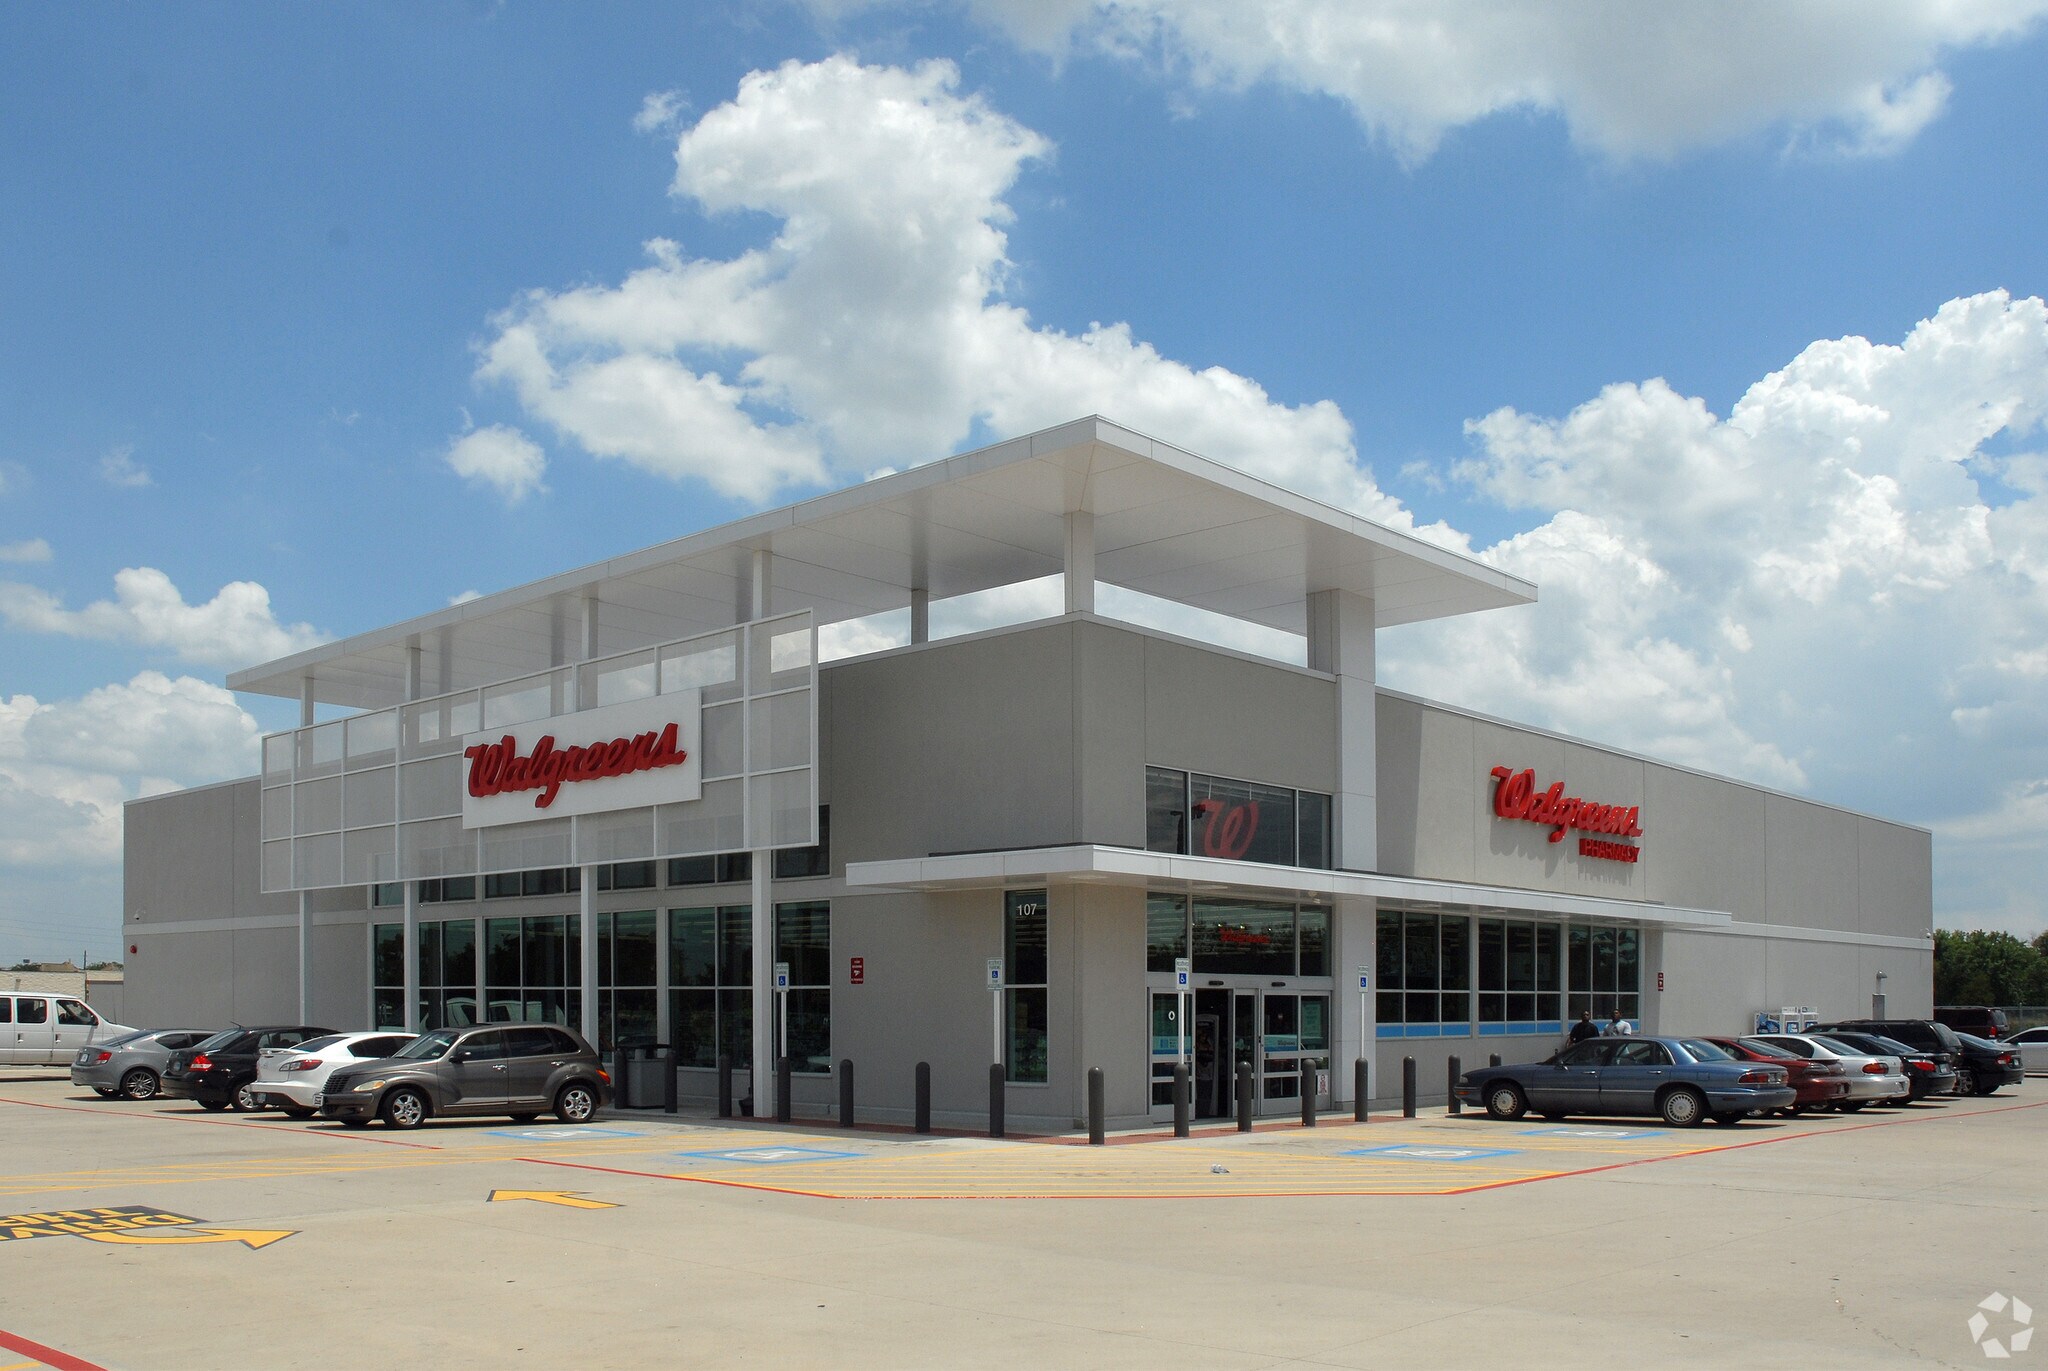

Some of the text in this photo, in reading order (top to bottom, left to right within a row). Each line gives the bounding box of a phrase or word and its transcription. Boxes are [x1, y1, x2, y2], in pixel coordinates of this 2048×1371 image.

[464, 722, 687, 808] Walgreens
[1194, 797, 1258, 859] W
[1490, 766, 1643, 843] Walgreens
[1579, 838, 1640, 863] PHARMACY
[1017, 903, 1037, 916] 107
